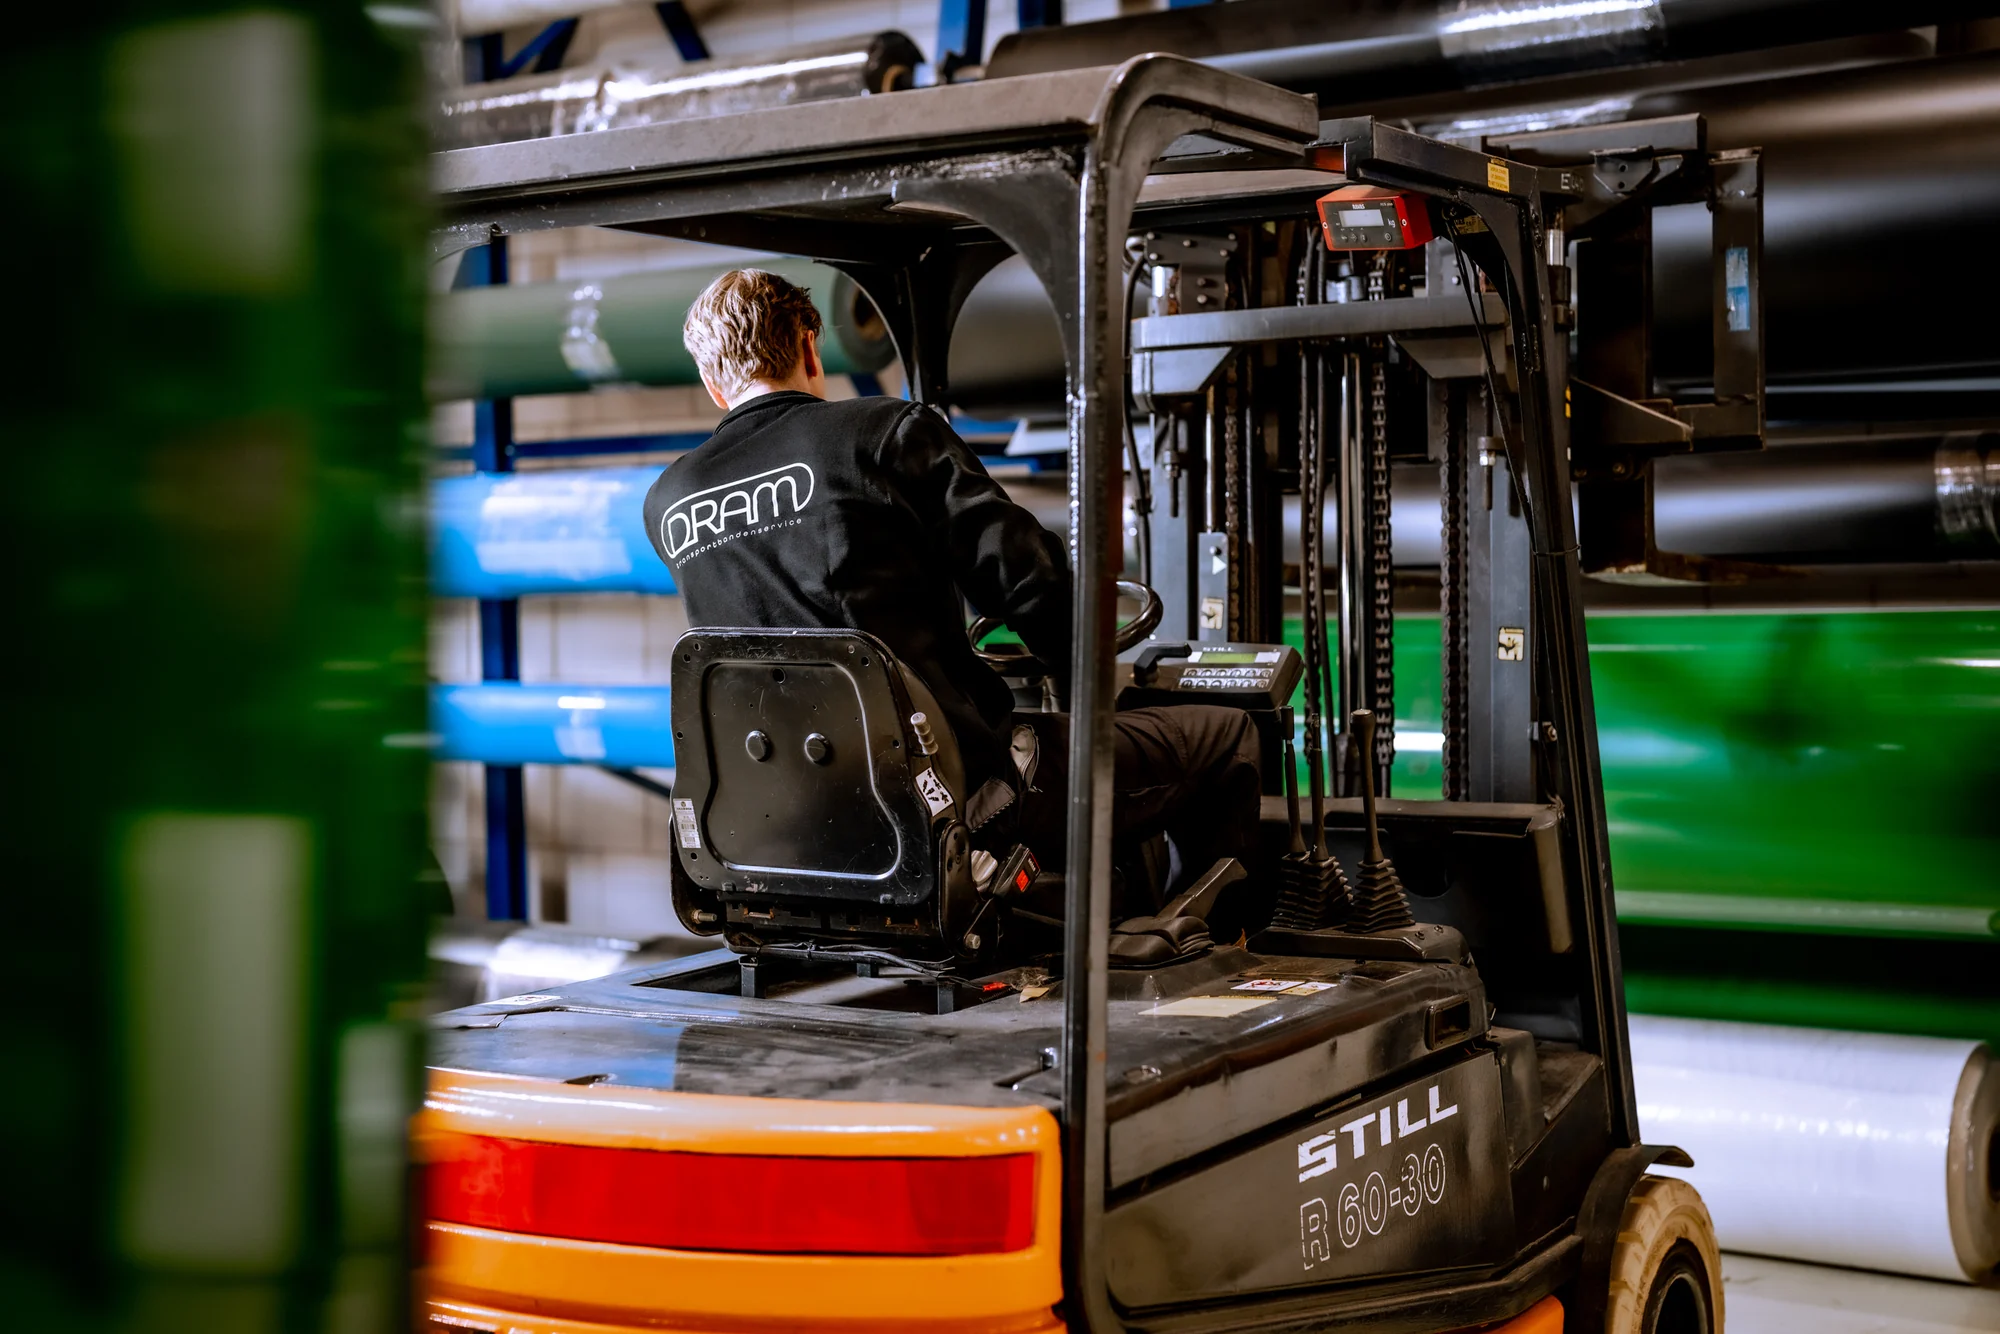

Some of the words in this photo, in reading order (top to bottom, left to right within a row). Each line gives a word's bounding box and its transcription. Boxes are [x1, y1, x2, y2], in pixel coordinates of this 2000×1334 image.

[666, 474, 803, 558] DRAM
[676, 518, 802, 569] transportbandenservice
[1298, 1085, 1458, 1183] STILL
[1300, 1197, 1331, 1271] R
[1338, 1143, 1446, 1249] 60-30
